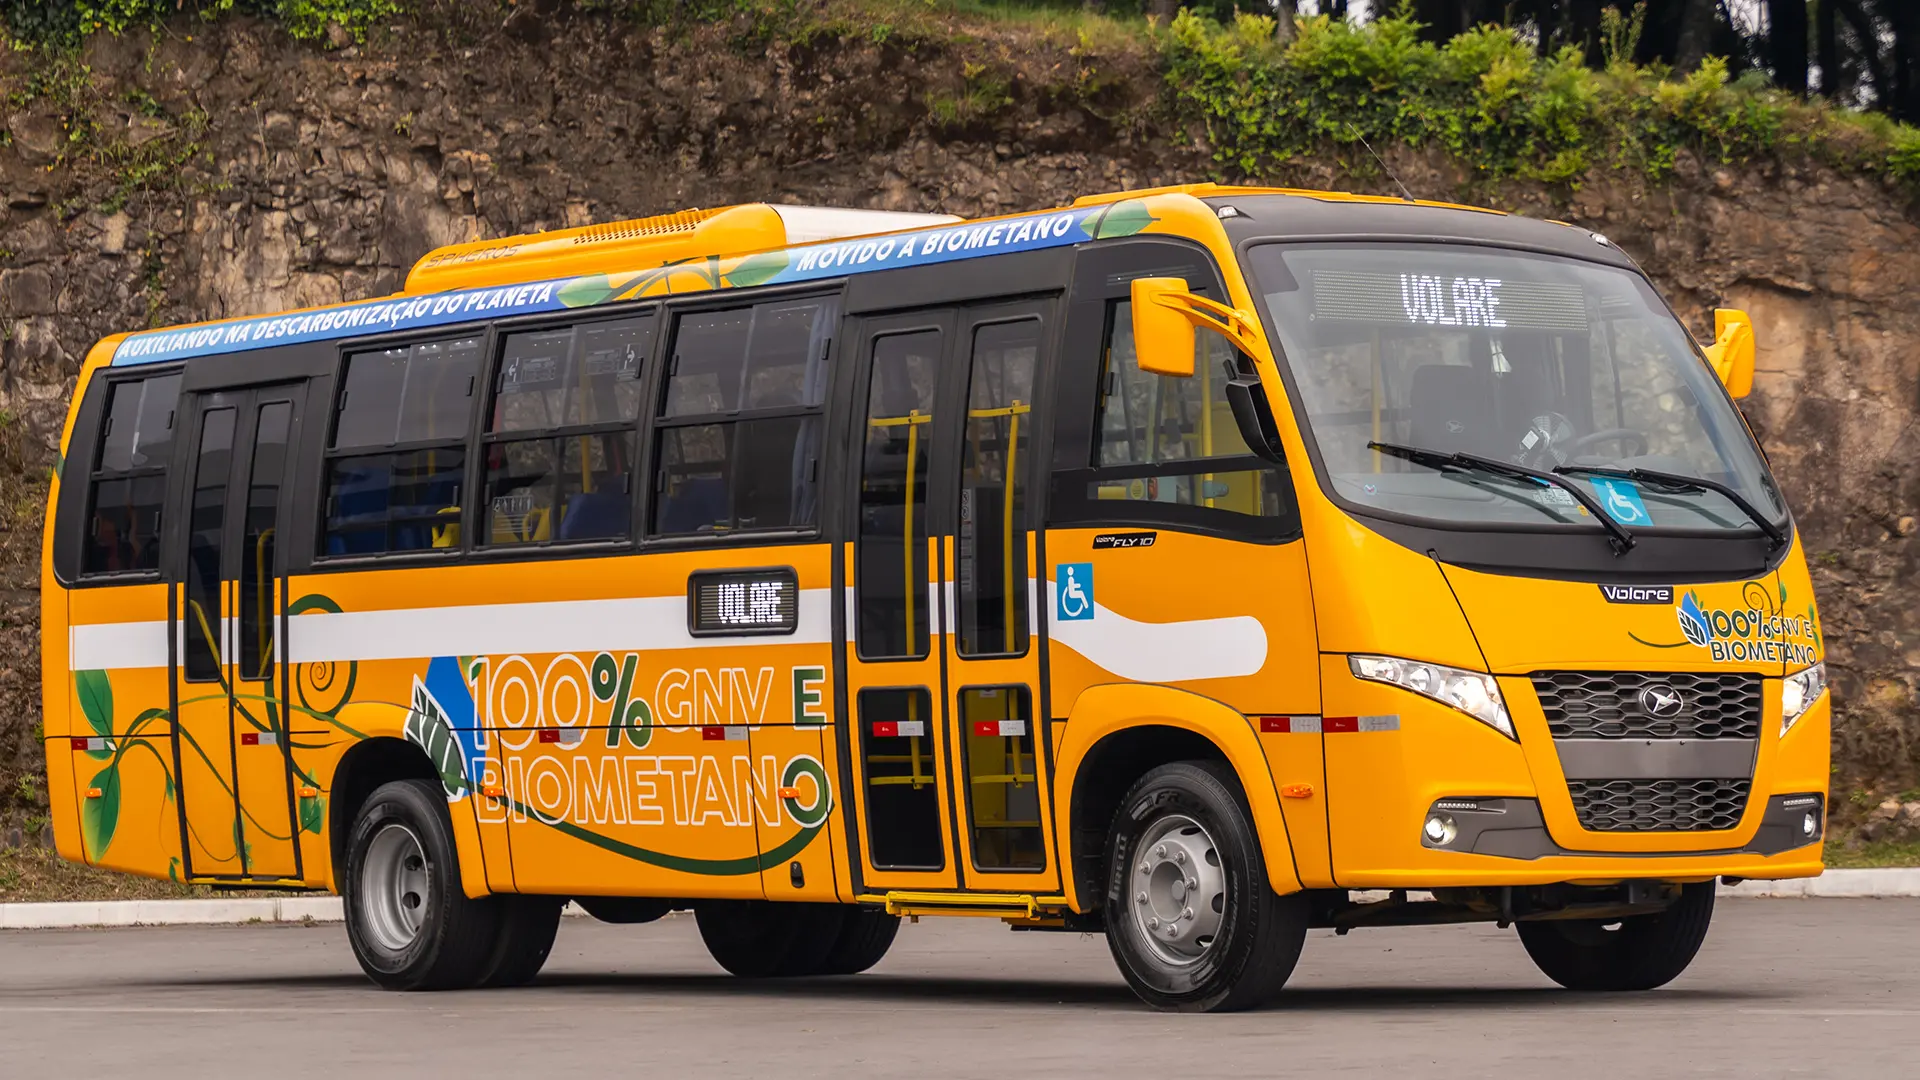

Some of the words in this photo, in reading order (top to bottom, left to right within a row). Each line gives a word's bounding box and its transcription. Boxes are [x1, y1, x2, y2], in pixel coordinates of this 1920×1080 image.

[425, 243, 523, 268] SPHEROS
[796, 239, 896, 272] MOVIDO
[897, 236, 917, 258] A
[921, 214, 1074, 255] BIOMETANO
[1400, 272, 1507, 327] VOLARE
[117, 326, 225, 359] AUXILIANDO
[223, 323, 252, 345] NA
[251, 296, 433, 341] DESCARBONIZAÇÃO
[431, 294, 465, 316] DO
[463, 283, 554, 312] PLANETA
[1112, 538, 1138, 547] FLY
[1139, 537, 1154, 546] 10
[718, 582, 783, 624] VOLARE
[1603, 585, 1669, 601] Volare
[1700, 609, 1773, 639] 100%
[1769, 615, 1800, 637] GNV
[1803, 619, 1815, 639] E
[1709, 640, 1817, 666] BIOMETANO
[468, 651, 653, 751] 100%
[655, 666, 774, 732] GNV
[791, 665, 826, 730] E
[471, 754, 833, 829] BIOMETANO
